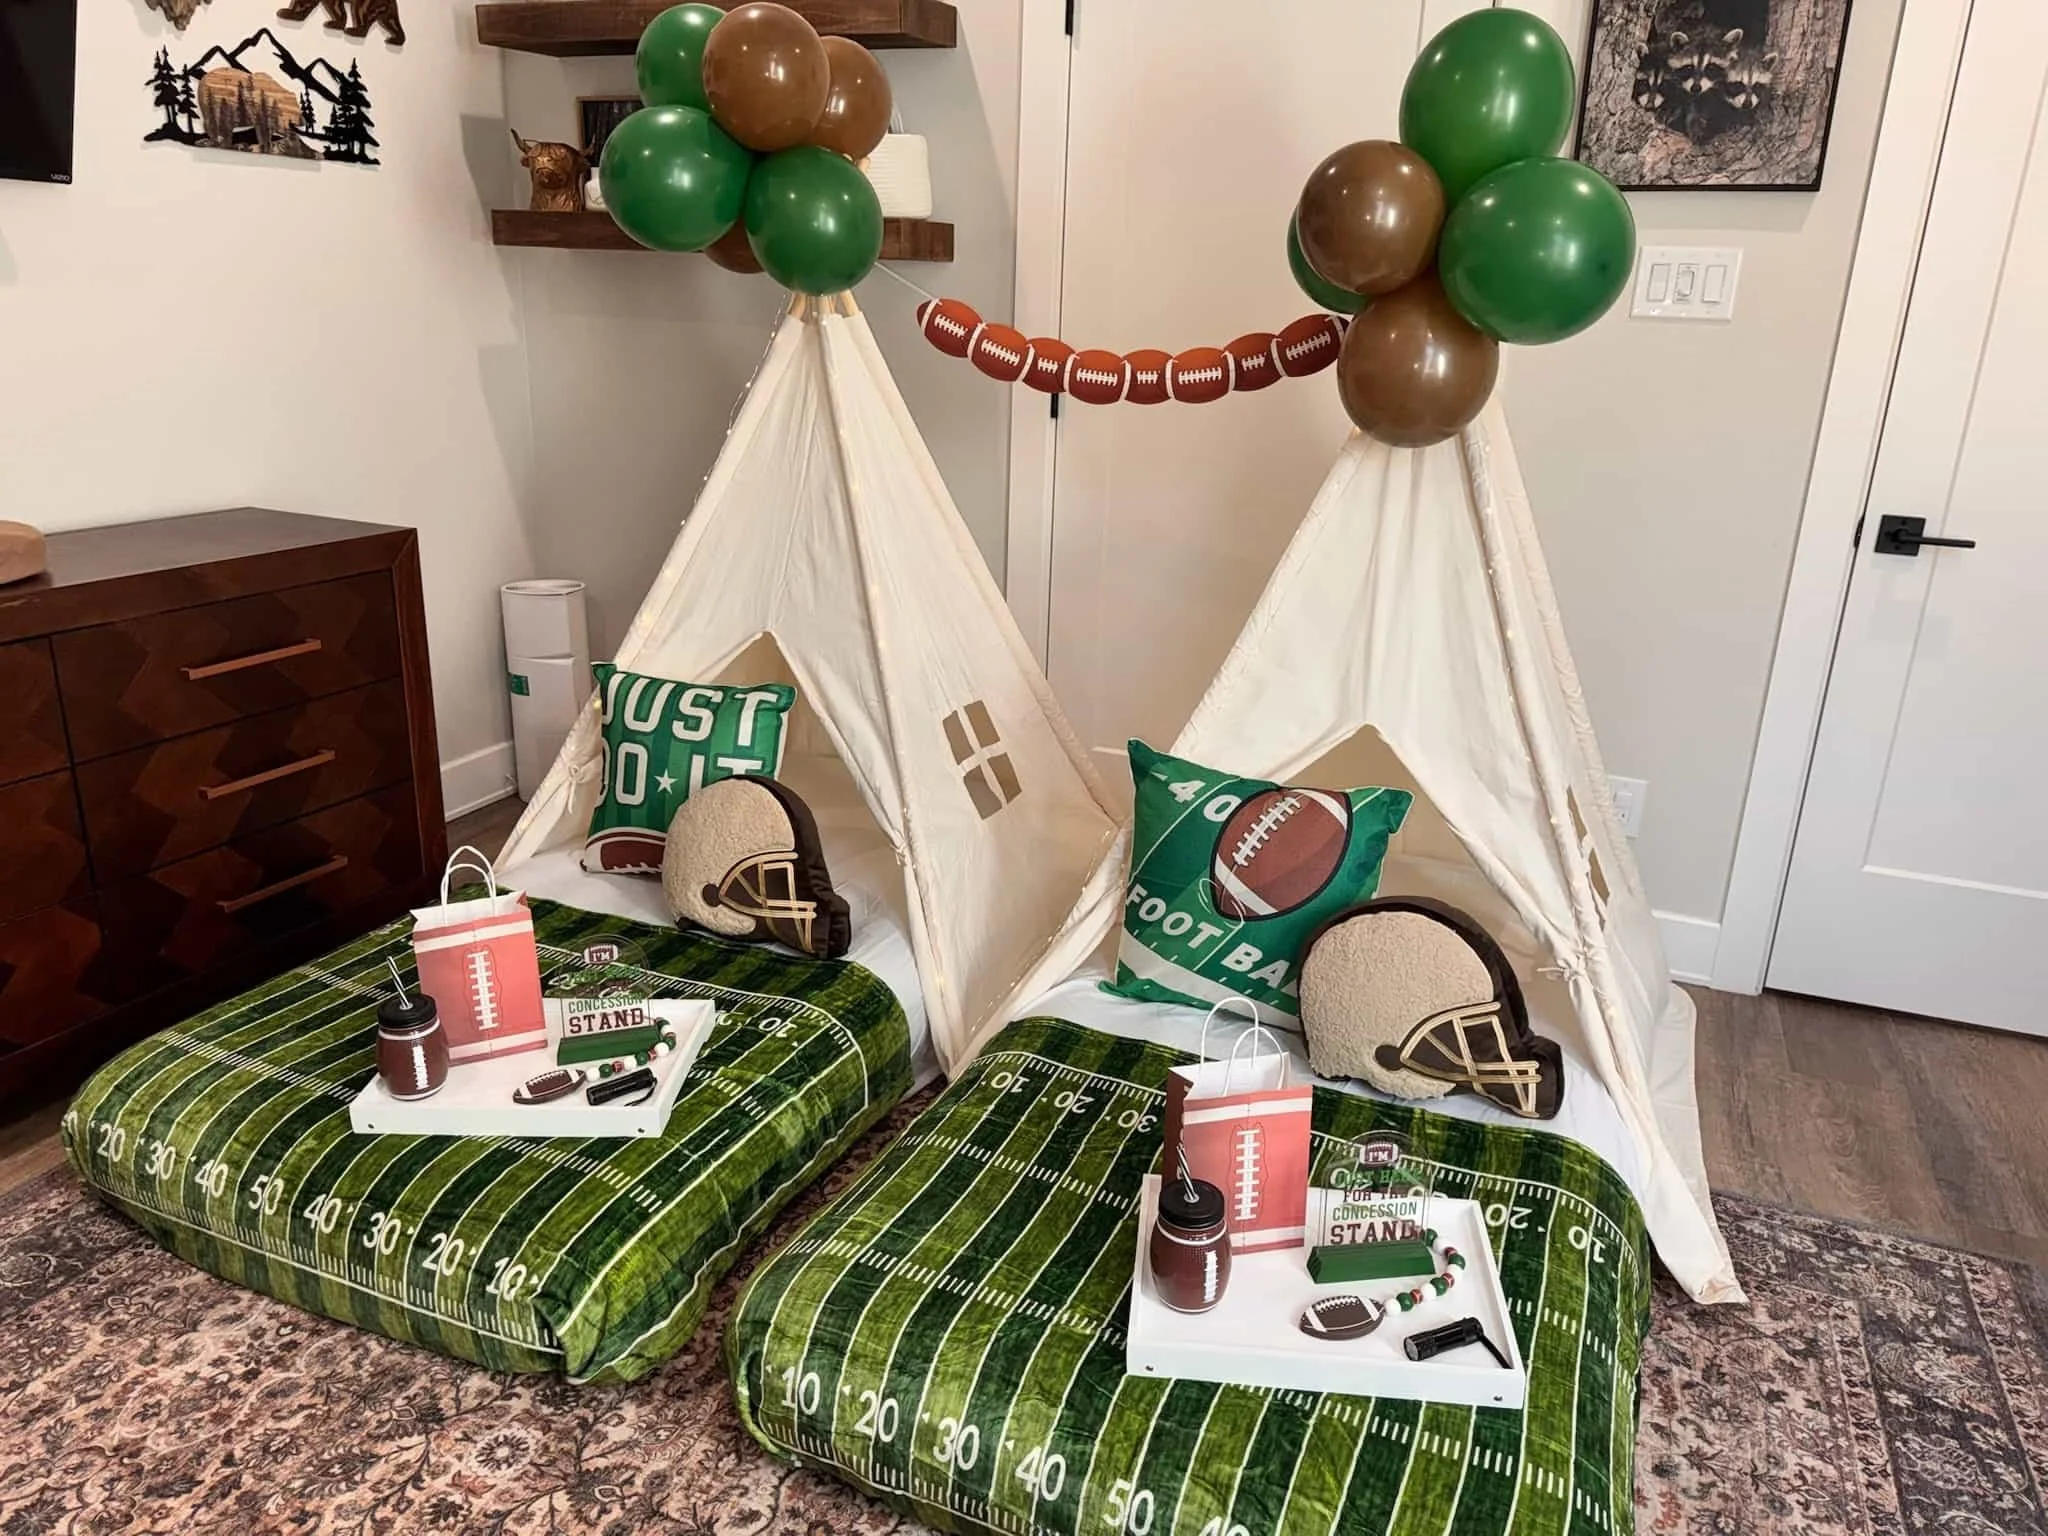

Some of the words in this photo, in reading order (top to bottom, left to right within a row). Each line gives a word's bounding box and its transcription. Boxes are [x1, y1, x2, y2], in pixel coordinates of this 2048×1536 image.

[602, 673, 779, 747] JUST
[1126, 884, 1225, 949] FOOT
[1220, 942, 1297, 999] BA
[568, 992, 643, 1014] CONCESSION
[569, 1008, 645, 1034] STAND
[96, 1123, 126, 1162] 20
[144, 1140, 177, 1179] 30
[195, 1160, 229, 1197] 40
[248, 1174, 285, 1215] 50
[303, 1193, 343, 1233] 40
[363, 1211, 402, 1255] 30
[422, 1232, 465, 1275] 20
[486, 1256, 527, 1301] 10
[1330, 1220, 1416, 1245] STAND
[1332, 1202, 1418, 1221] CONCESSION
[782, 1366, 821, 1415] 10
[854, 1390, 899, 1442] 20
[933, 1416, 980, 1471] 30
[1015, 1446, 1067, 1501] 40
[1103, 1478, 1155, 1536] 50
